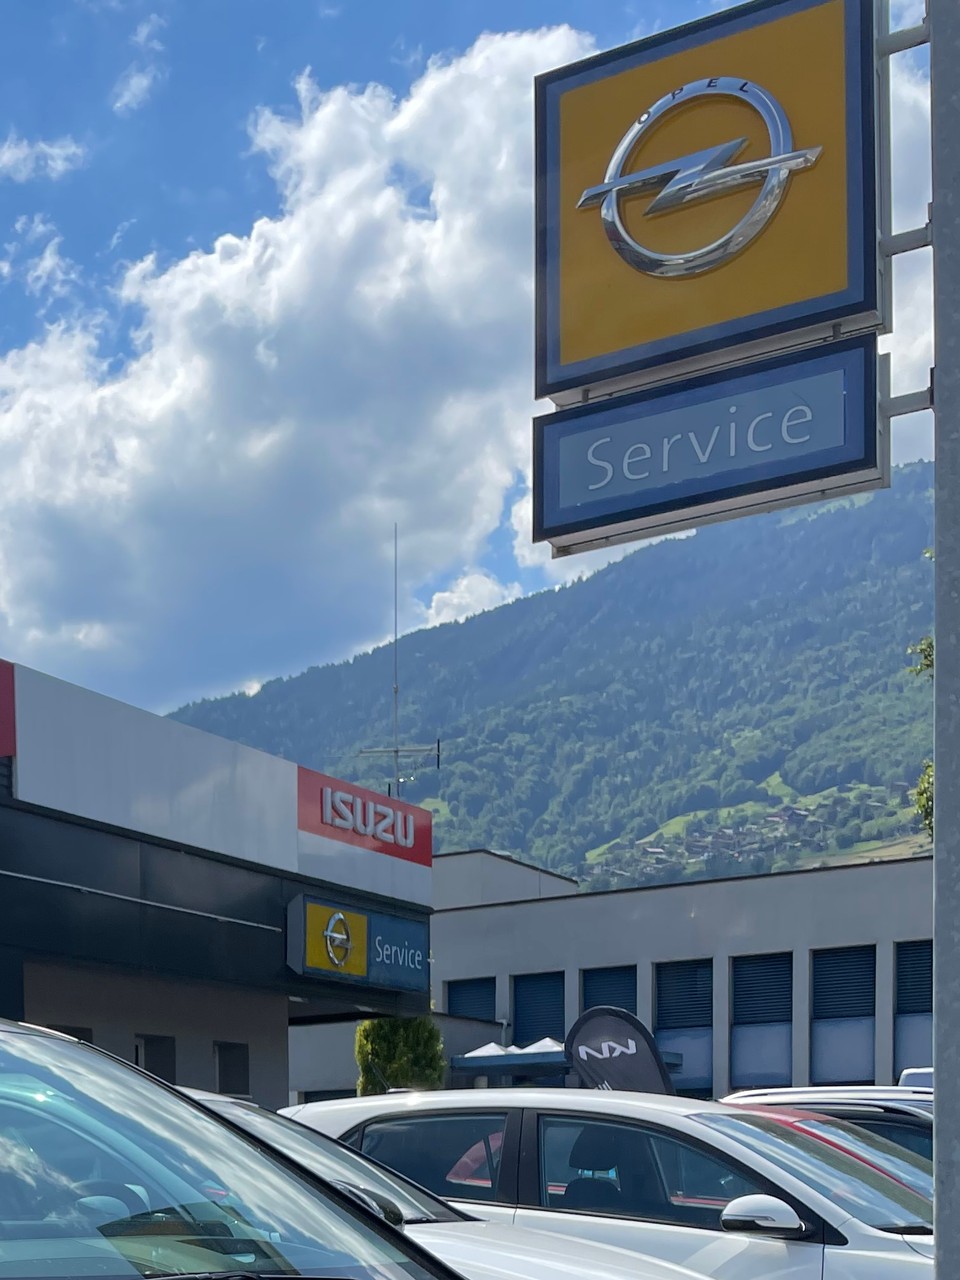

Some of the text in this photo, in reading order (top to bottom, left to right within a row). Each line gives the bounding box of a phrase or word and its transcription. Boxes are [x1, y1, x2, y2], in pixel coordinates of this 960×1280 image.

[637, 76, 751, 125] OPEL
[586, 404, 814, 491] Service
[321, 787, 414, 848] ISUZU
[375, 936, 422, 969] Service
